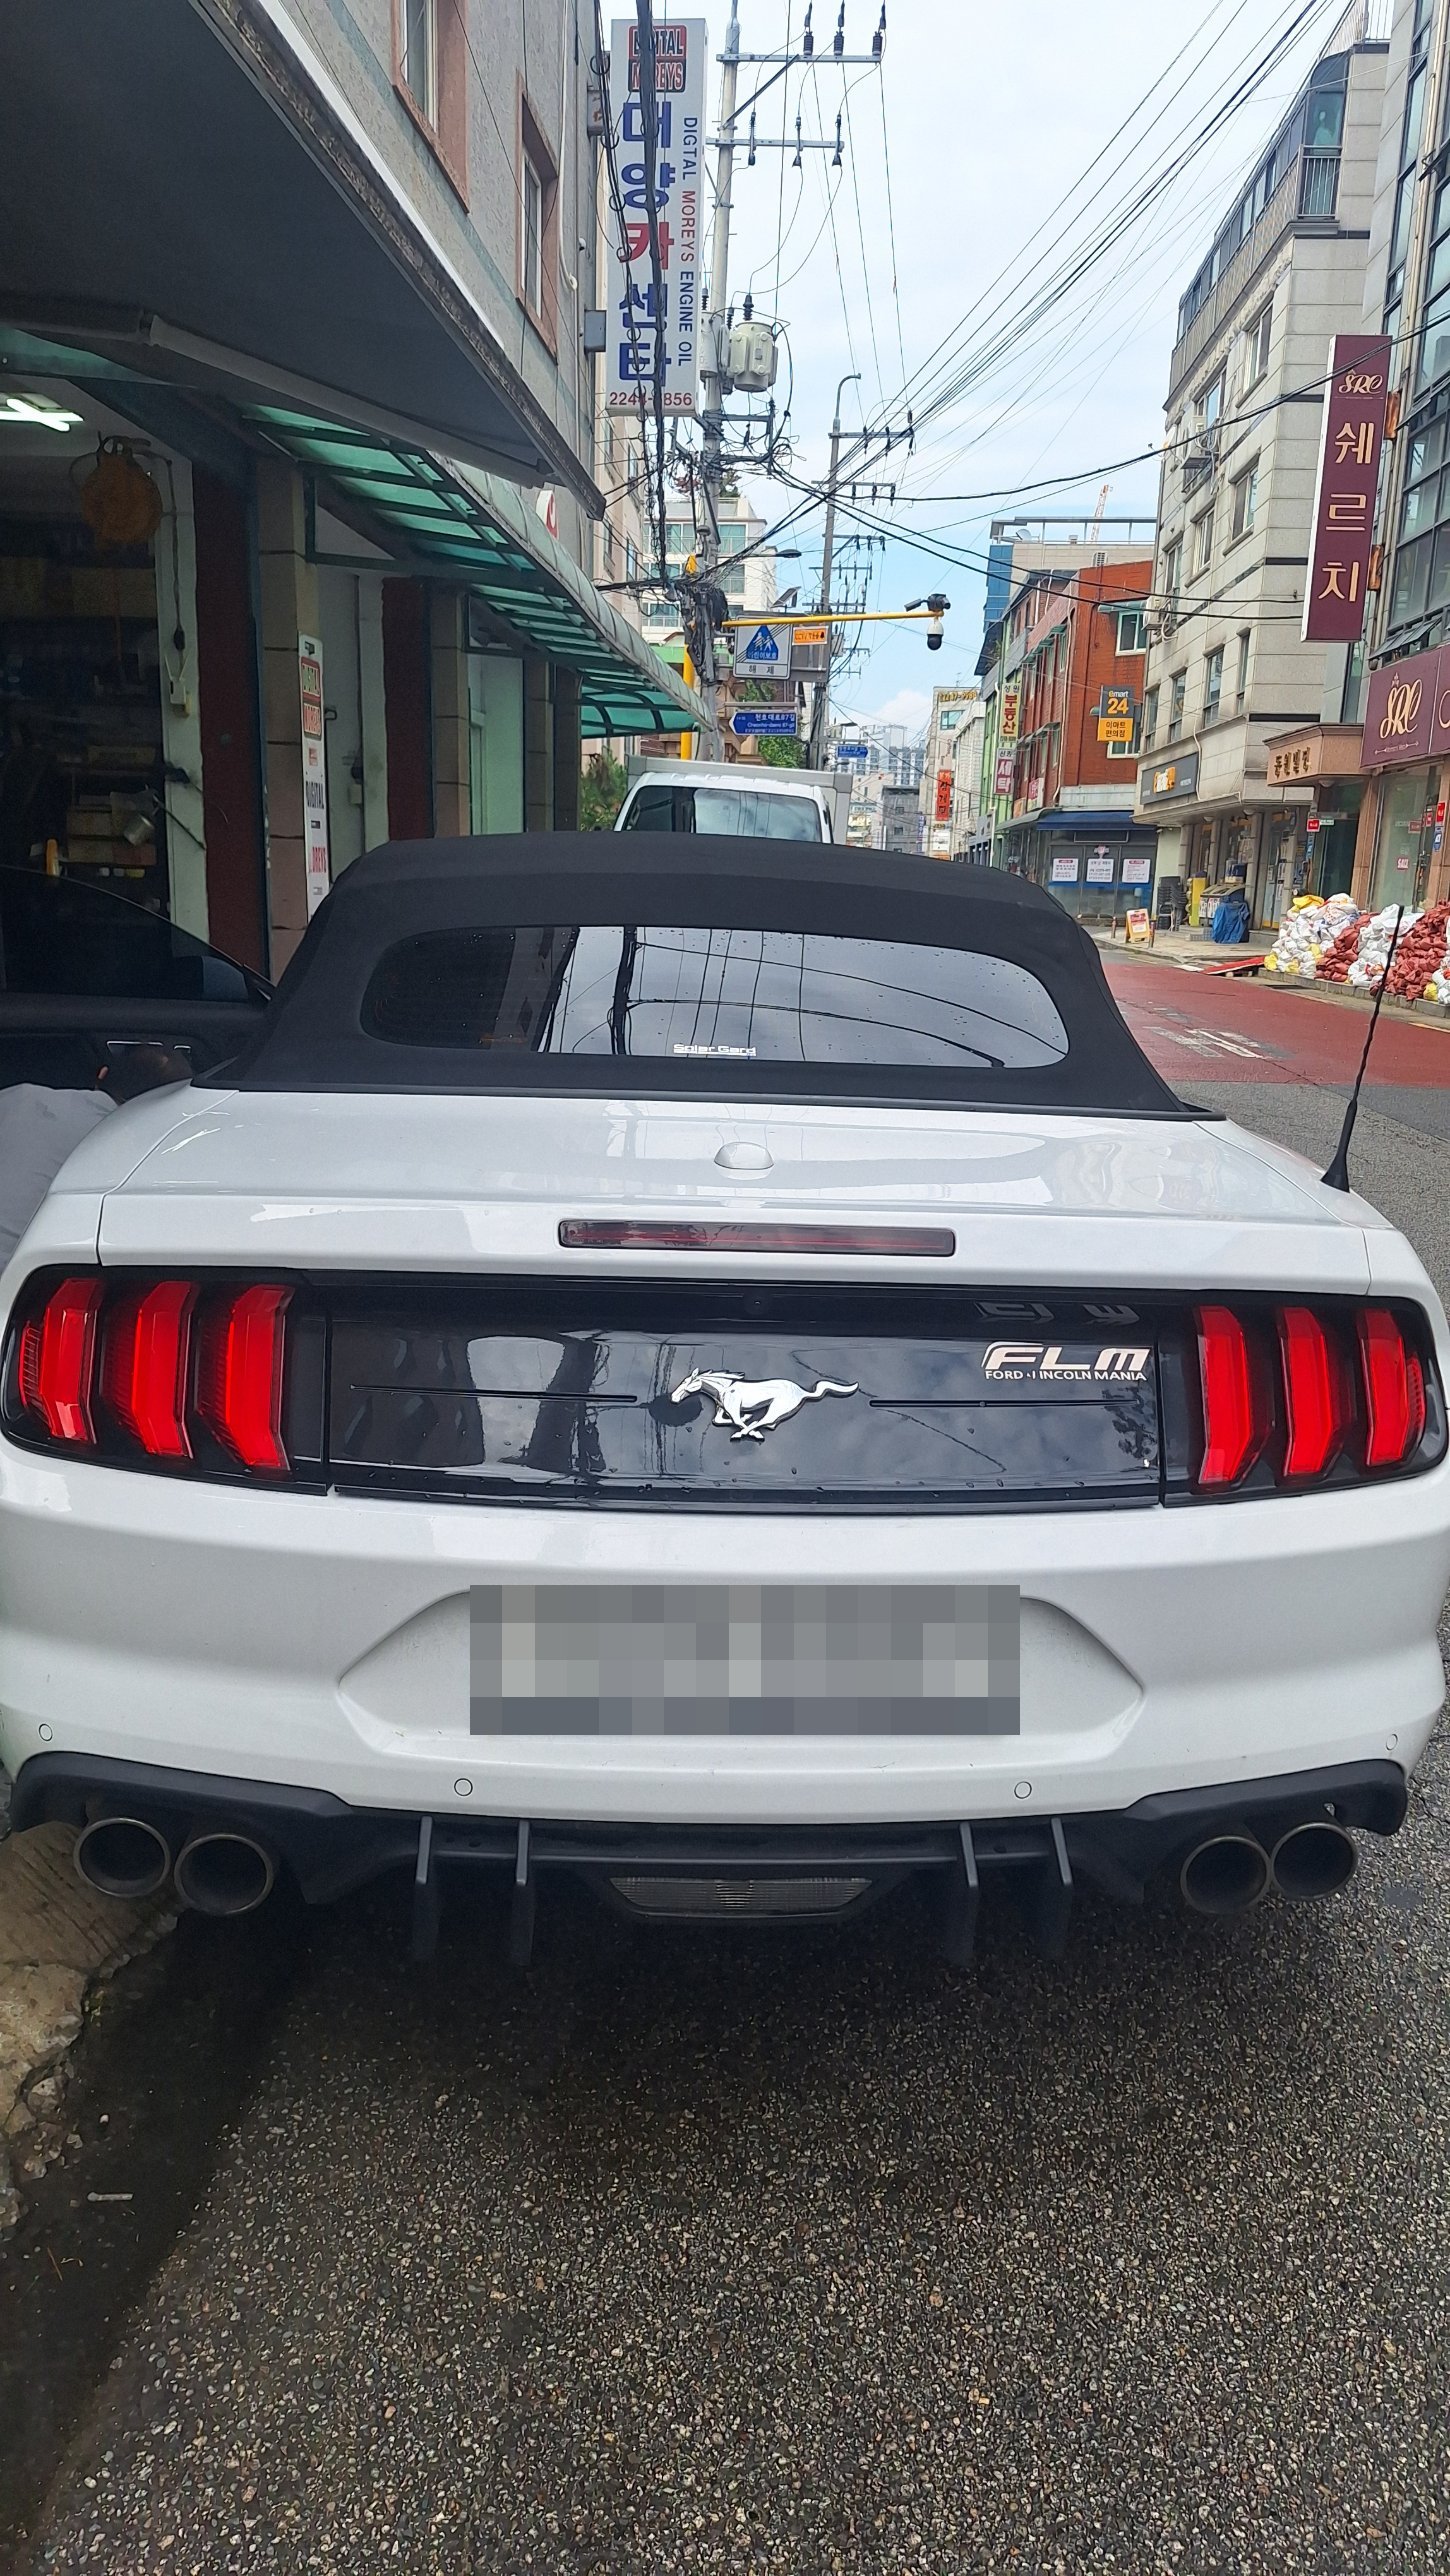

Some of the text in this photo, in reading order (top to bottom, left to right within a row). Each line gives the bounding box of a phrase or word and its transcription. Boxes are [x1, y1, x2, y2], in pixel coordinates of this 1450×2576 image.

[678, 117, 698, 366] DIGTAL MOREYS ENGINE OIL
[609, 391, 693, 405] 2244-856
[1318, 422, 1375, 602] 쉐르치
[1108, 690, 1129, 698] emart
[1107, 697, 1129, 715] 24
[1002, 694, 1018, 735] 부동산
[1106, 721, 1126, 729] 이마트
[1106, 730, 1125, 738] 편의점
[998, 760, 1013, 793] 세탁
[717, 1045, 756, 1054] Gard
[981, 1341, 1150, 1371] FLM
[985, 1371, 1024, 1380] FORD
[1094, 1371, 1148, 1381] MANIA
